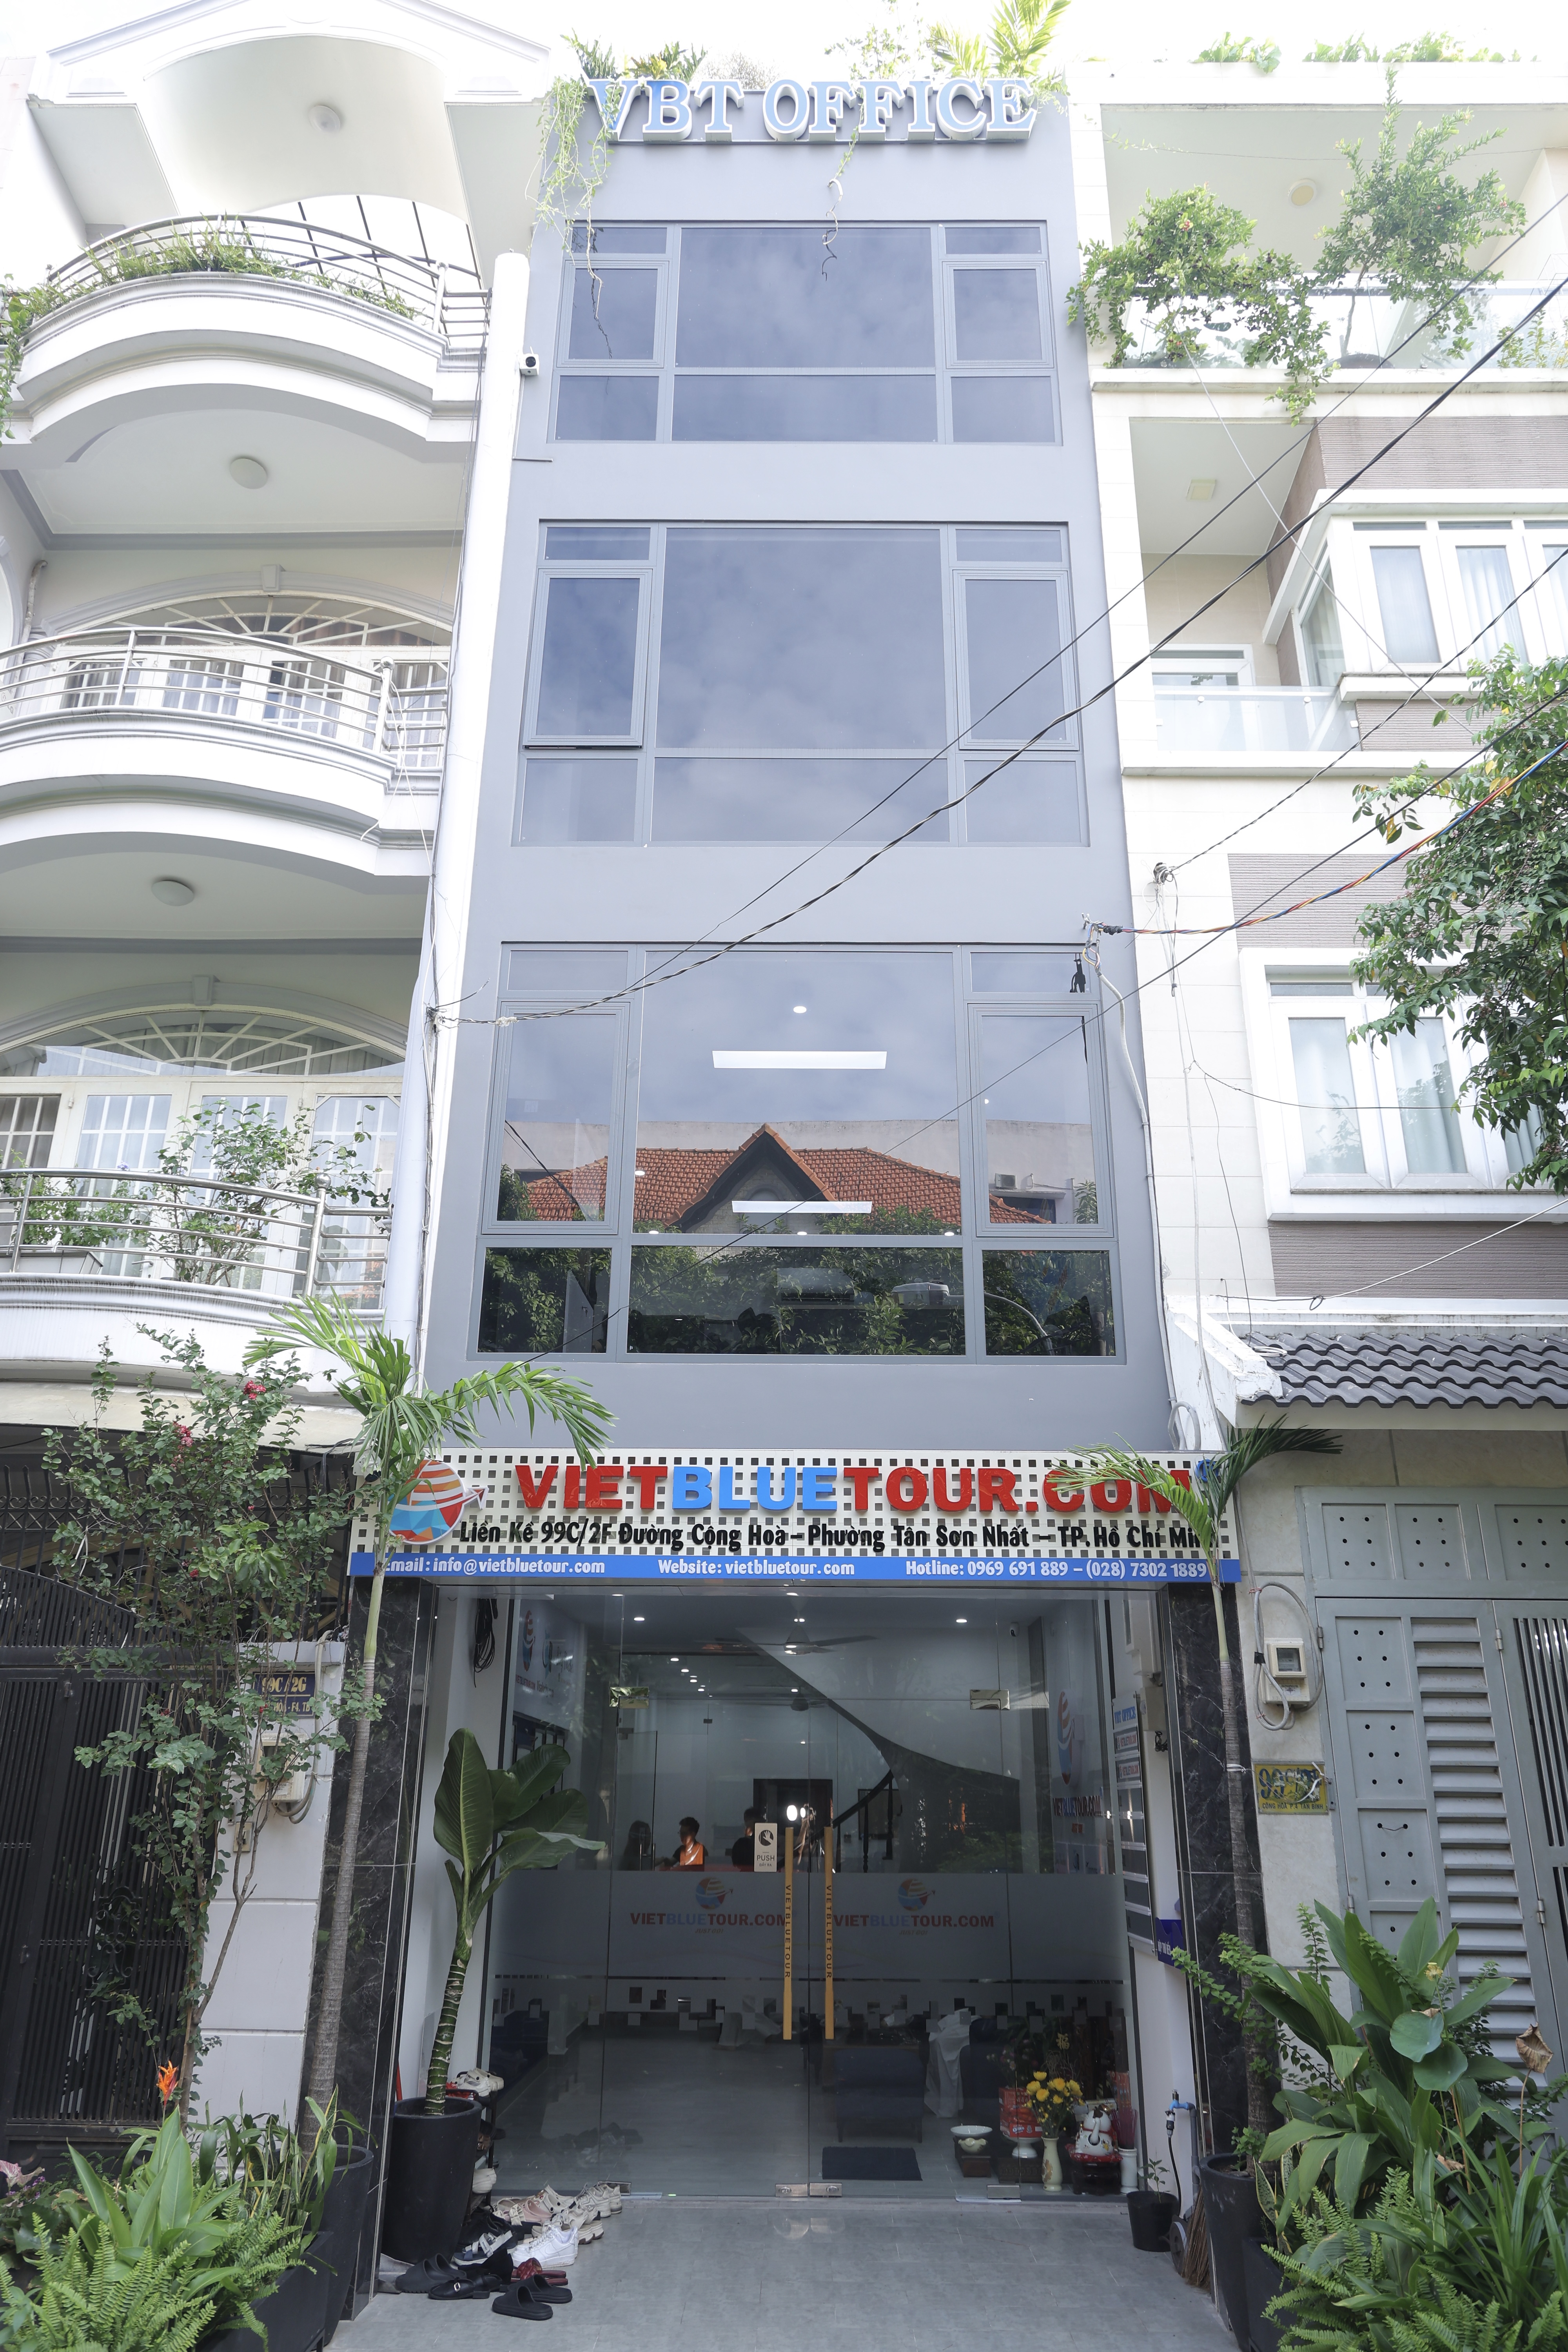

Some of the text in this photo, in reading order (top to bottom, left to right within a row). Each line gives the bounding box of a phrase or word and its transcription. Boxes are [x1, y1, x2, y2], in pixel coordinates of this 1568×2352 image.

[588, 78, 1037, 142] VBT OFFICE
[460, 1520, 501, 1542] Liền
[509, 1521, 534, 1543] Kề
[541, 1518, 612, 1546] 99C/2F
[618, 1523, 684, 1552] Đường
[691, 1523, 741, 1552] Cộng
[748, 1524, 784, 1546] Hoà
[808, 1523, 885, 1553] Phường
[893, 1525, 927, 1546] Tân
[936, 1525, 974, 1547] Sơn
[982, 1524, 1030, 1547] Nhất
[1093, 1525, 1120, 1547] Hồ
[1127, 1525, 1161, 1548] Chí
[658, 1559, 722, 1575] Website:
[725, 1560, 855, 1575] vietbluetour.com
[906, 1560, 964, 1575] Hotline:
[967, 1561, 1004, 1576] 0969
[1009, 1561, 1036, 1576] 691
[1040, 1561, 1069, 1576] 889
[1086, 1559, 1125, 1579] (028)
[1130, 1563, 1167, 1577] 7302
[1170, 1563, 1207, 1577] 1889
[833, 1915, 994, 1927] VIETBLUETOUR.COM
